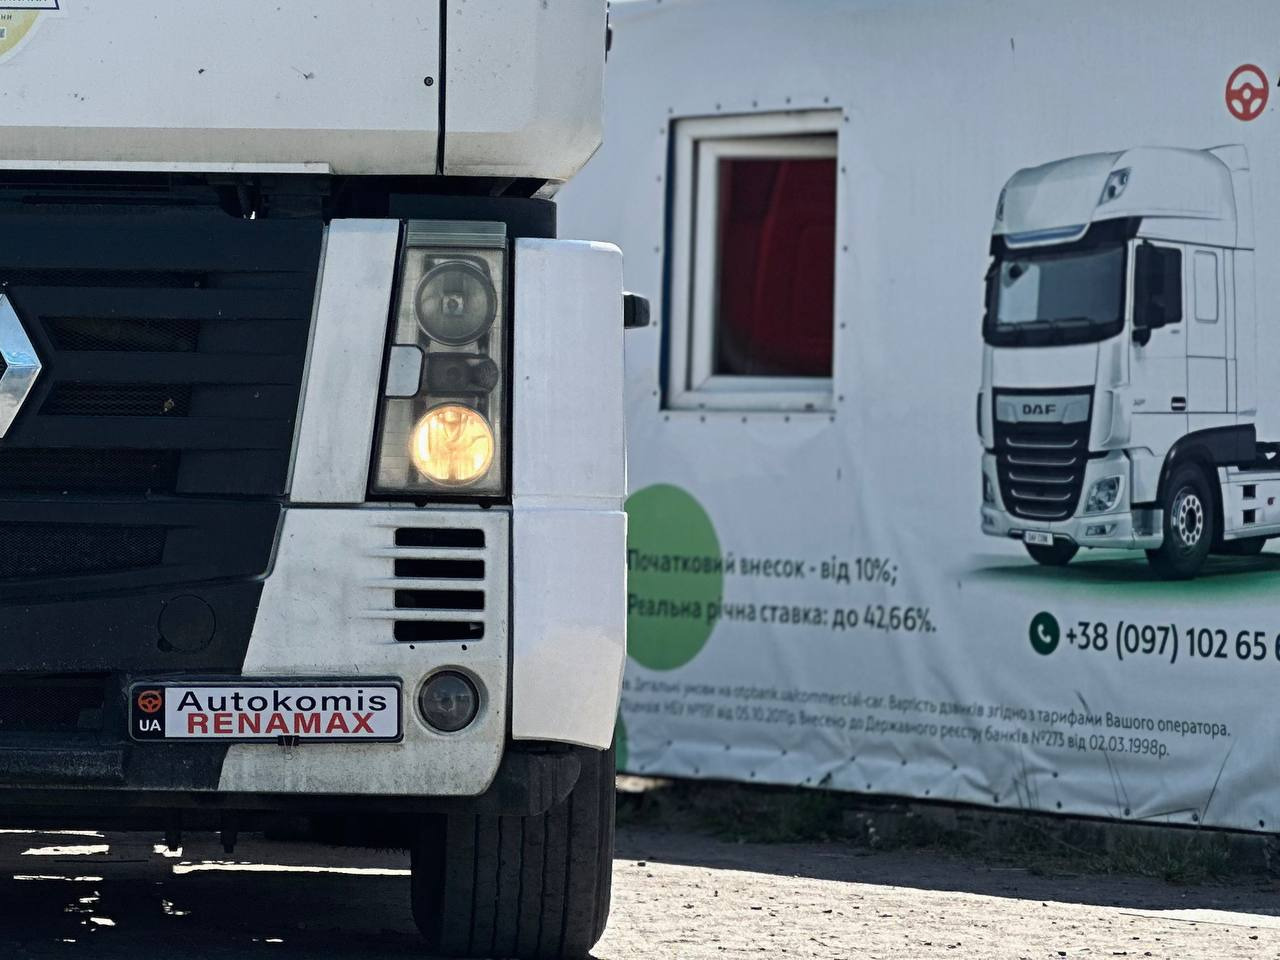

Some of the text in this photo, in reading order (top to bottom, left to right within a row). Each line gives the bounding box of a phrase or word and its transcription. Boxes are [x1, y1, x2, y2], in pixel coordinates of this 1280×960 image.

[1022, 403, 1056, 415] DAF
[740, 557, 805, 579] внесок
[821, 555, 850, 585] від
[855, 557, 898, 587] 10%;
[627, 593, 937, 634] Реальна річна ставка: до 42,66%.
[1066, 621, 1109, 651] +38
[1116, 620, 1178, 664] (097)
[1186, 627, 1228, 659] 102
[1235, 630, 1267, 661] 65
[177, 690, 387, 712] Autokomis
[139, 719, 162, 732] UA
[187, 712, 374, 734] RENAMAX
[1038, 709, 1102, 727] тарифами
[1106, 712, 1155, 731] Вашого
[1157, 718, 1231, 740] оператора.
[1068, 733, 1086, 752] від
[1089, 734, 1170, 759] 02.03.1998р.
